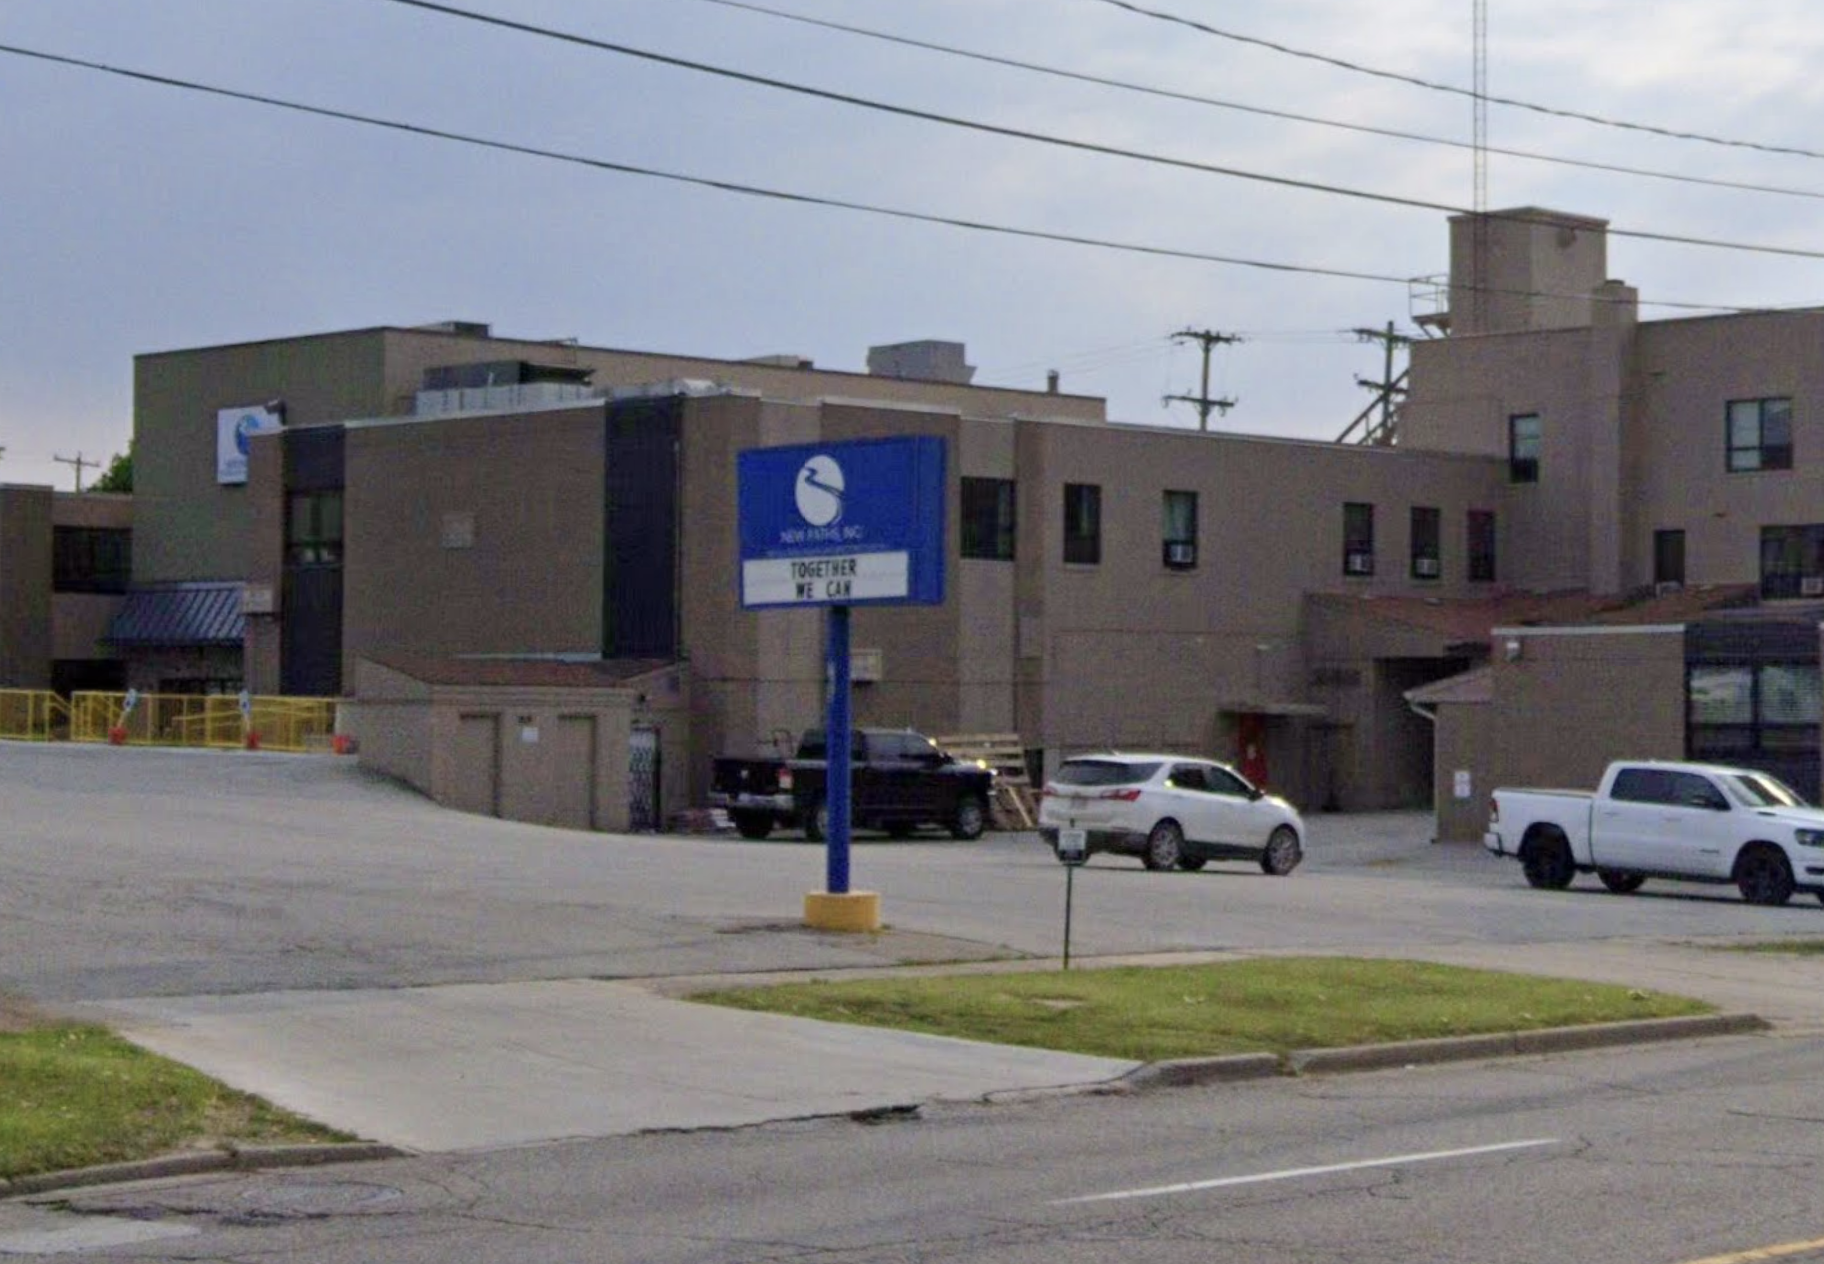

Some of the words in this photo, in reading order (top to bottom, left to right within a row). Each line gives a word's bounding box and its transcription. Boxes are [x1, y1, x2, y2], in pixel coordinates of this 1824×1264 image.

[791, 558, 857, 579] TOGETHER
[796, 582, 813, 599] WE
[826, 580, 851, 597] CAN
